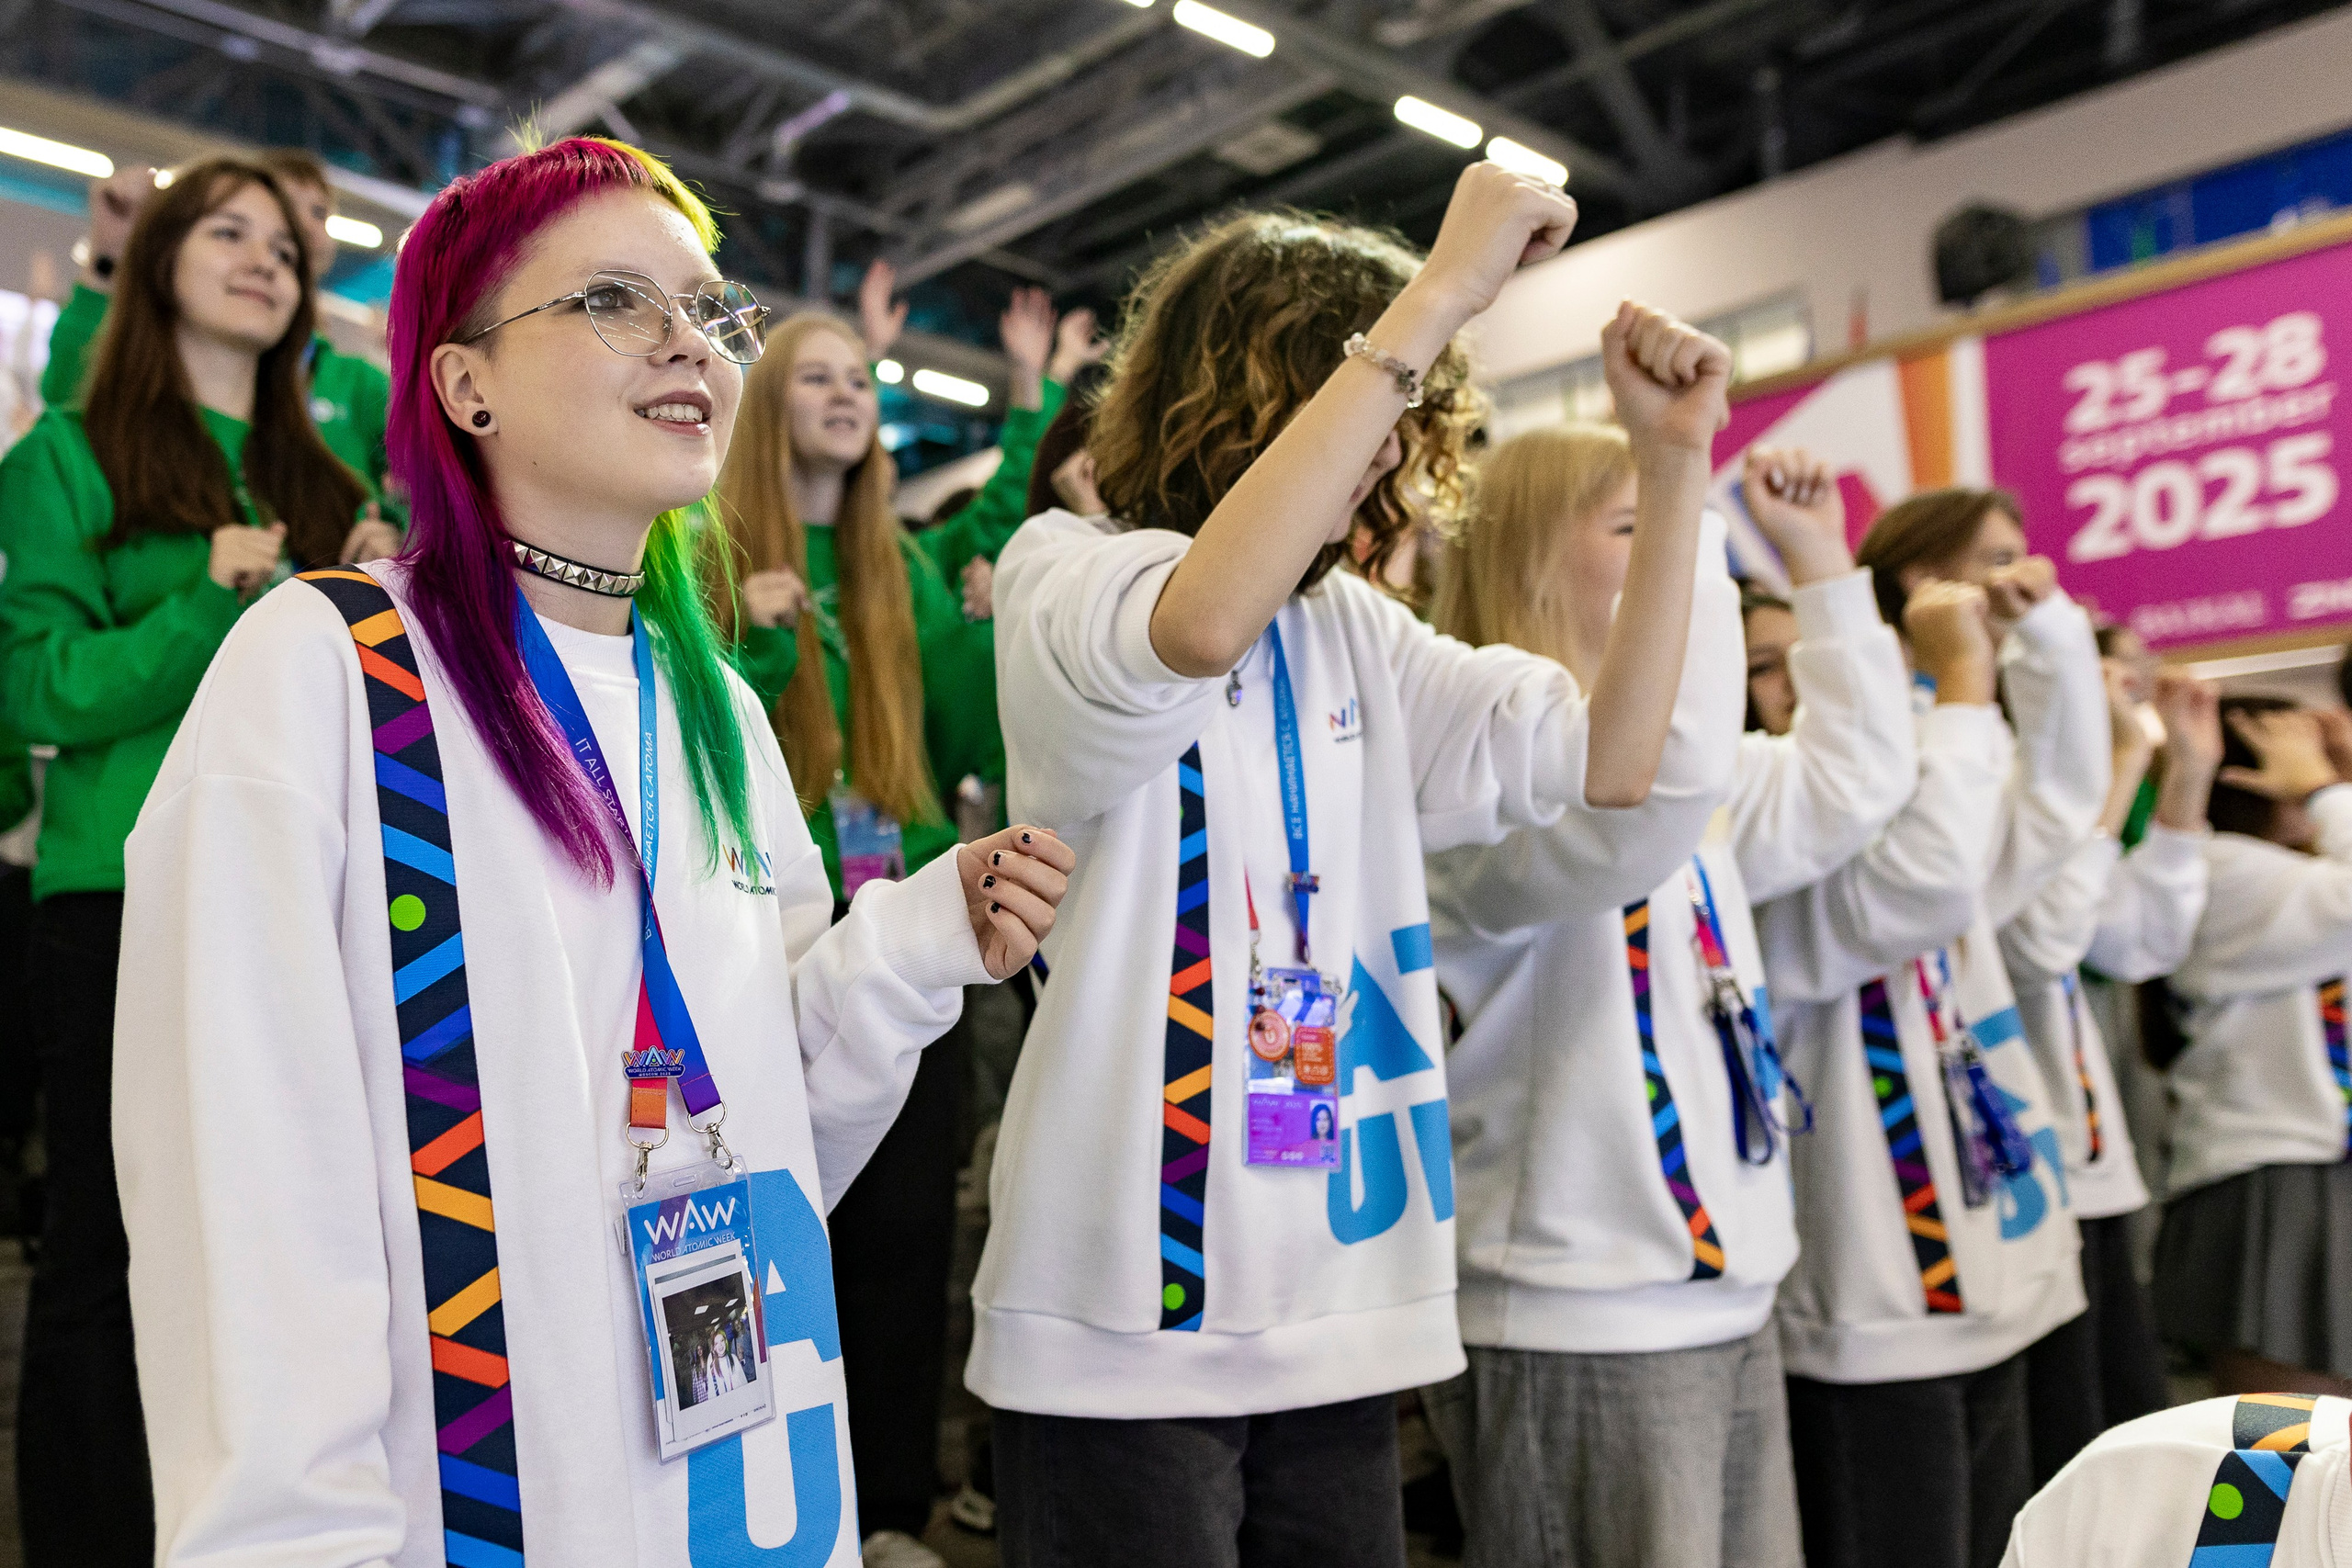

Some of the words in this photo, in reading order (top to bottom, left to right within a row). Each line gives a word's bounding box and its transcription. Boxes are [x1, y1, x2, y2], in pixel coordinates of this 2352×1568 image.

[2065, 431, 2339, 562] 2025
[575, 738, 593, 753] IT
[584, 758, 605, 787] ALL
[645, 732, 654, 786] АТОМА
[624, 1046, 683, 1066] WAW
[643, 1197, 736, 1246] WAW
[652, 1247, 682, 1262] WORLD
[682, 1237, 714, 1255] ATOMIC
[714, 1231, 736, 1246] WEEK
